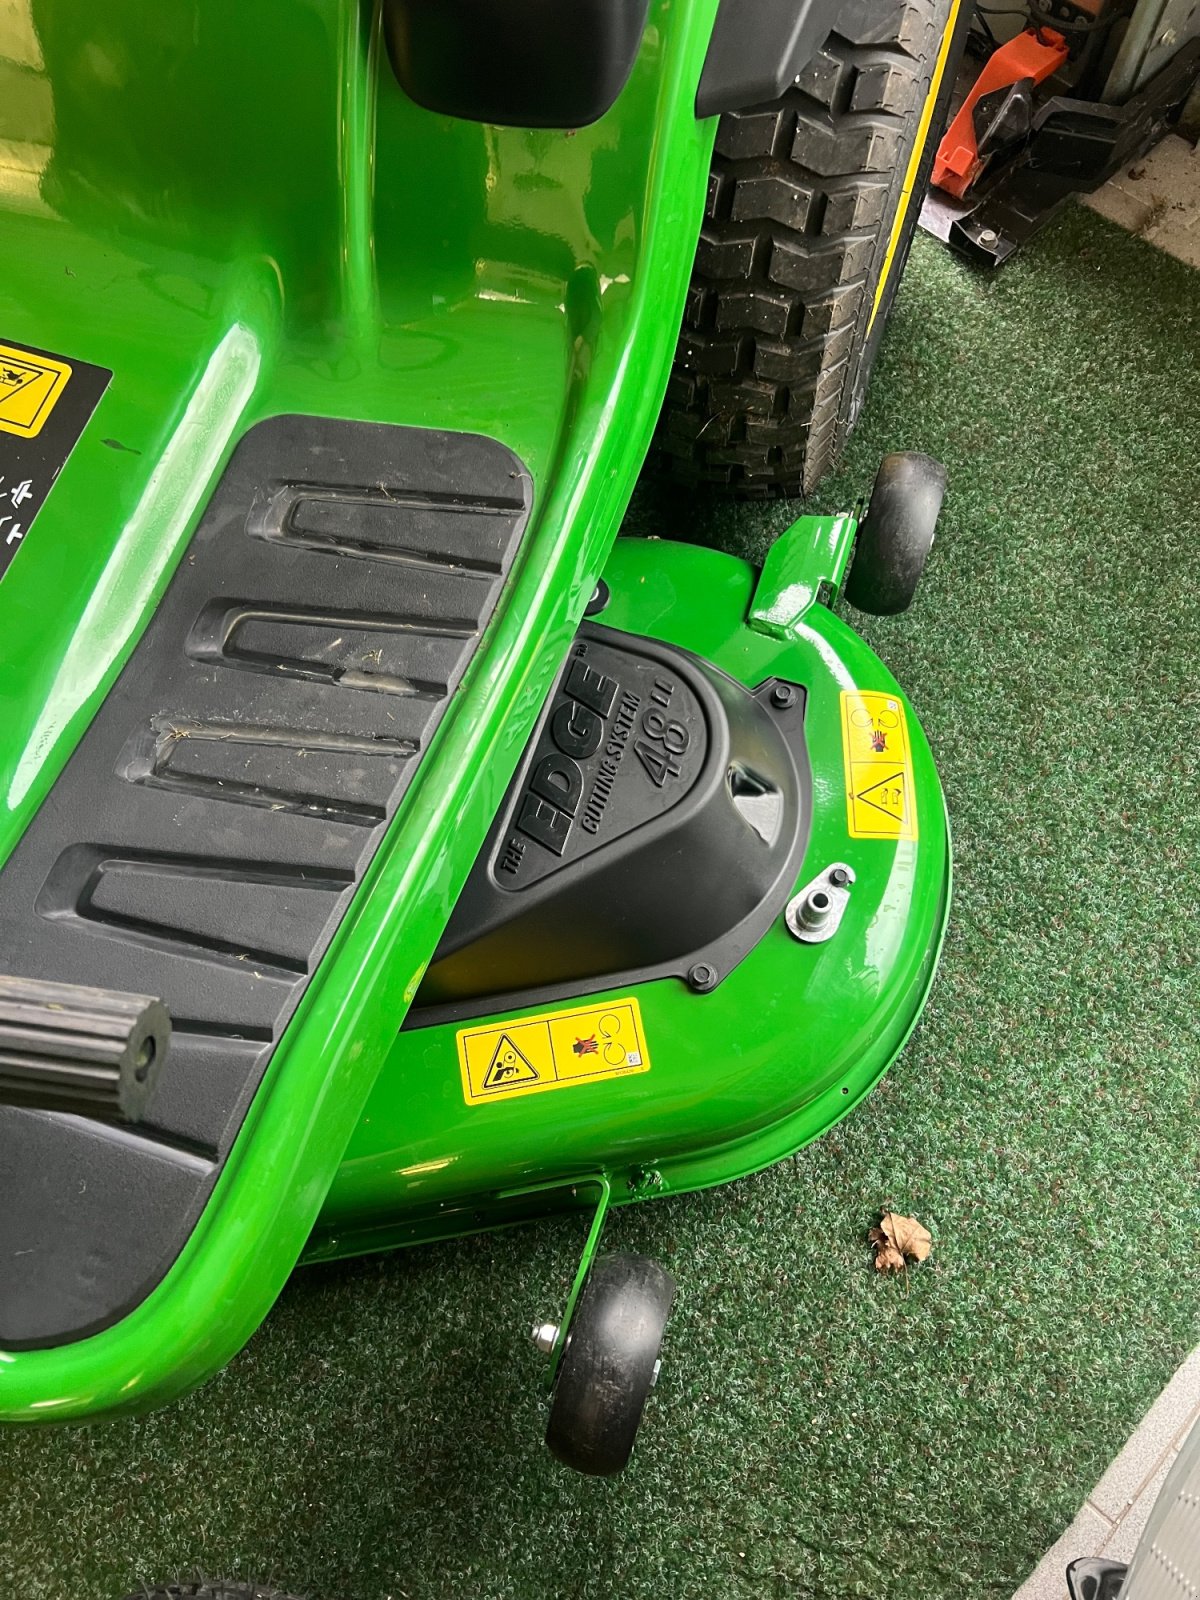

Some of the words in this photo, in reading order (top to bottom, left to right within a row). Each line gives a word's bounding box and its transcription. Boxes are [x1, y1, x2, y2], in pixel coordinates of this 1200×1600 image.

[502, 838, 526, 875] THE
[515, 658, 620, 857] EDGE
[582, 758, 619, 835] CUTTING
[606, 689, 642, 761] SYSTEM
